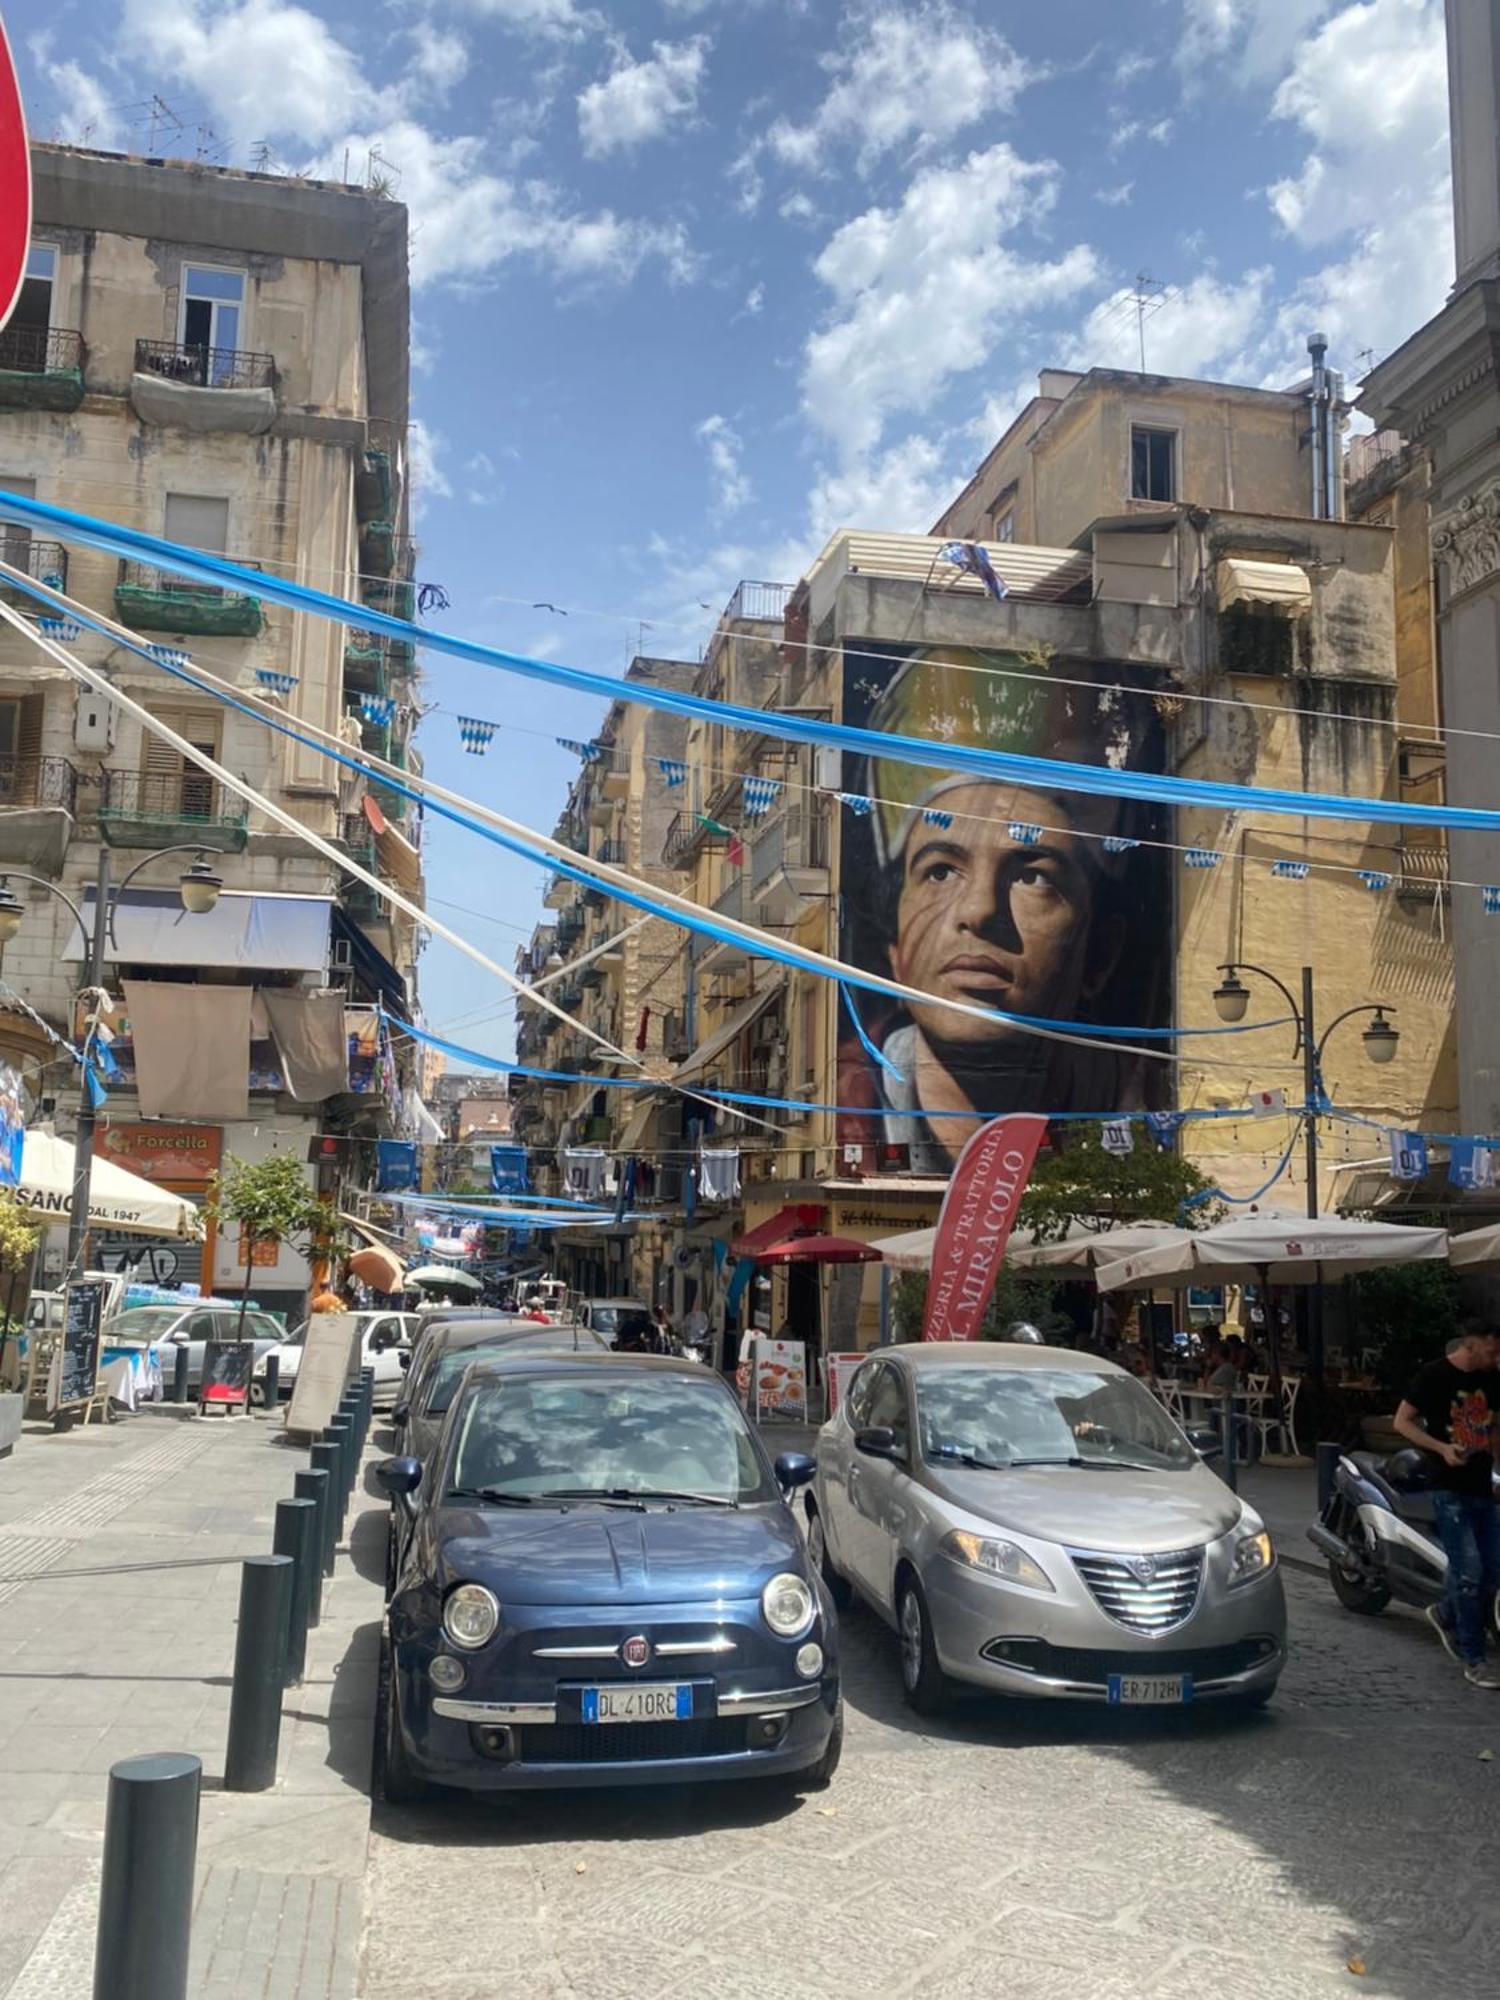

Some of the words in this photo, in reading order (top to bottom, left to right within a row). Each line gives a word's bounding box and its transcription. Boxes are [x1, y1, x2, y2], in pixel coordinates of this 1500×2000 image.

[137, 1134, 208, 1149] Forcella
[953, 1128, 1003, 1242] TRATTORIA
[114, 1209, 141, 1222] 1947
[955, 1149, 1025, 1314] MIRACOLO
[950, 1249, 964, 1264] &
[1122, 1681, 1139, 1698] ER
[599, 1695, 619, 1717] DL
[624, 1692, 676, 1716] 410RC
